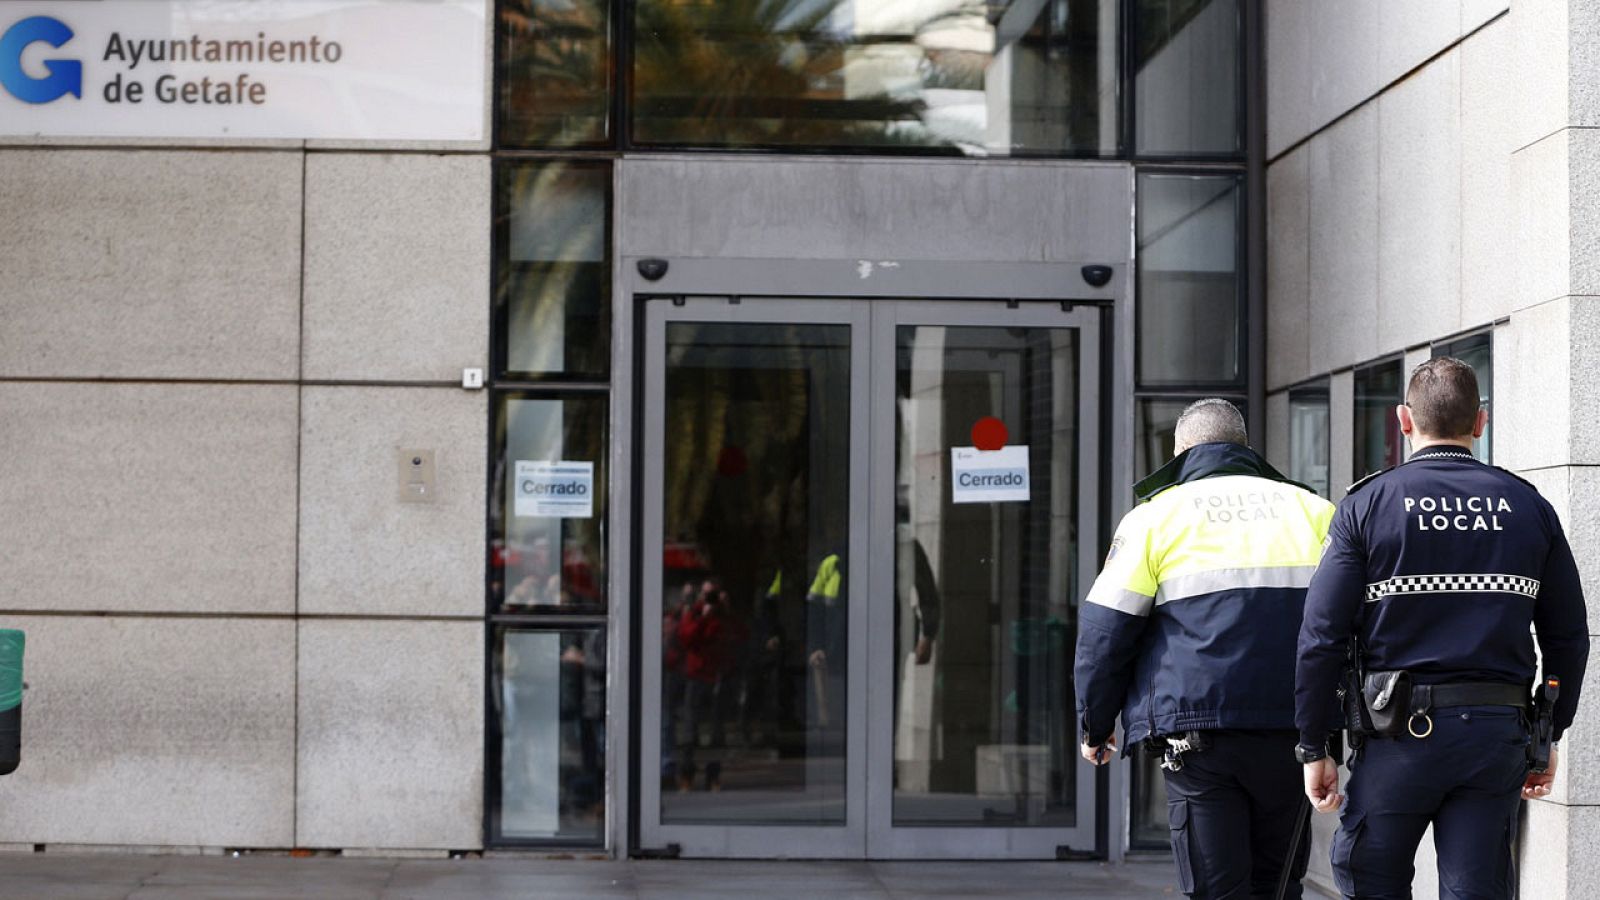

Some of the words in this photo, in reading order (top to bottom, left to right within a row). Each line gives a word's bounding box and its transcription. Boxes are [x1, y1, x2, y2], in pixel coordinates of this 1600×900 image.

[103, 33, 342, 69] Ayuntamiento
[103, 74, 143, 104] de
[155, 74, 267, 104] Getafe
[522, 480, 587, 495] Cerrado
[959, 472, 1023, 487] Cerrado
[1195, 491, 1286, 510] POLICIA
[1404, 497, 1512, 512] POLICIA
[1206, 507, 1278, 523] LOCAL
[1418, 515, 1503, 531] LOCAL
